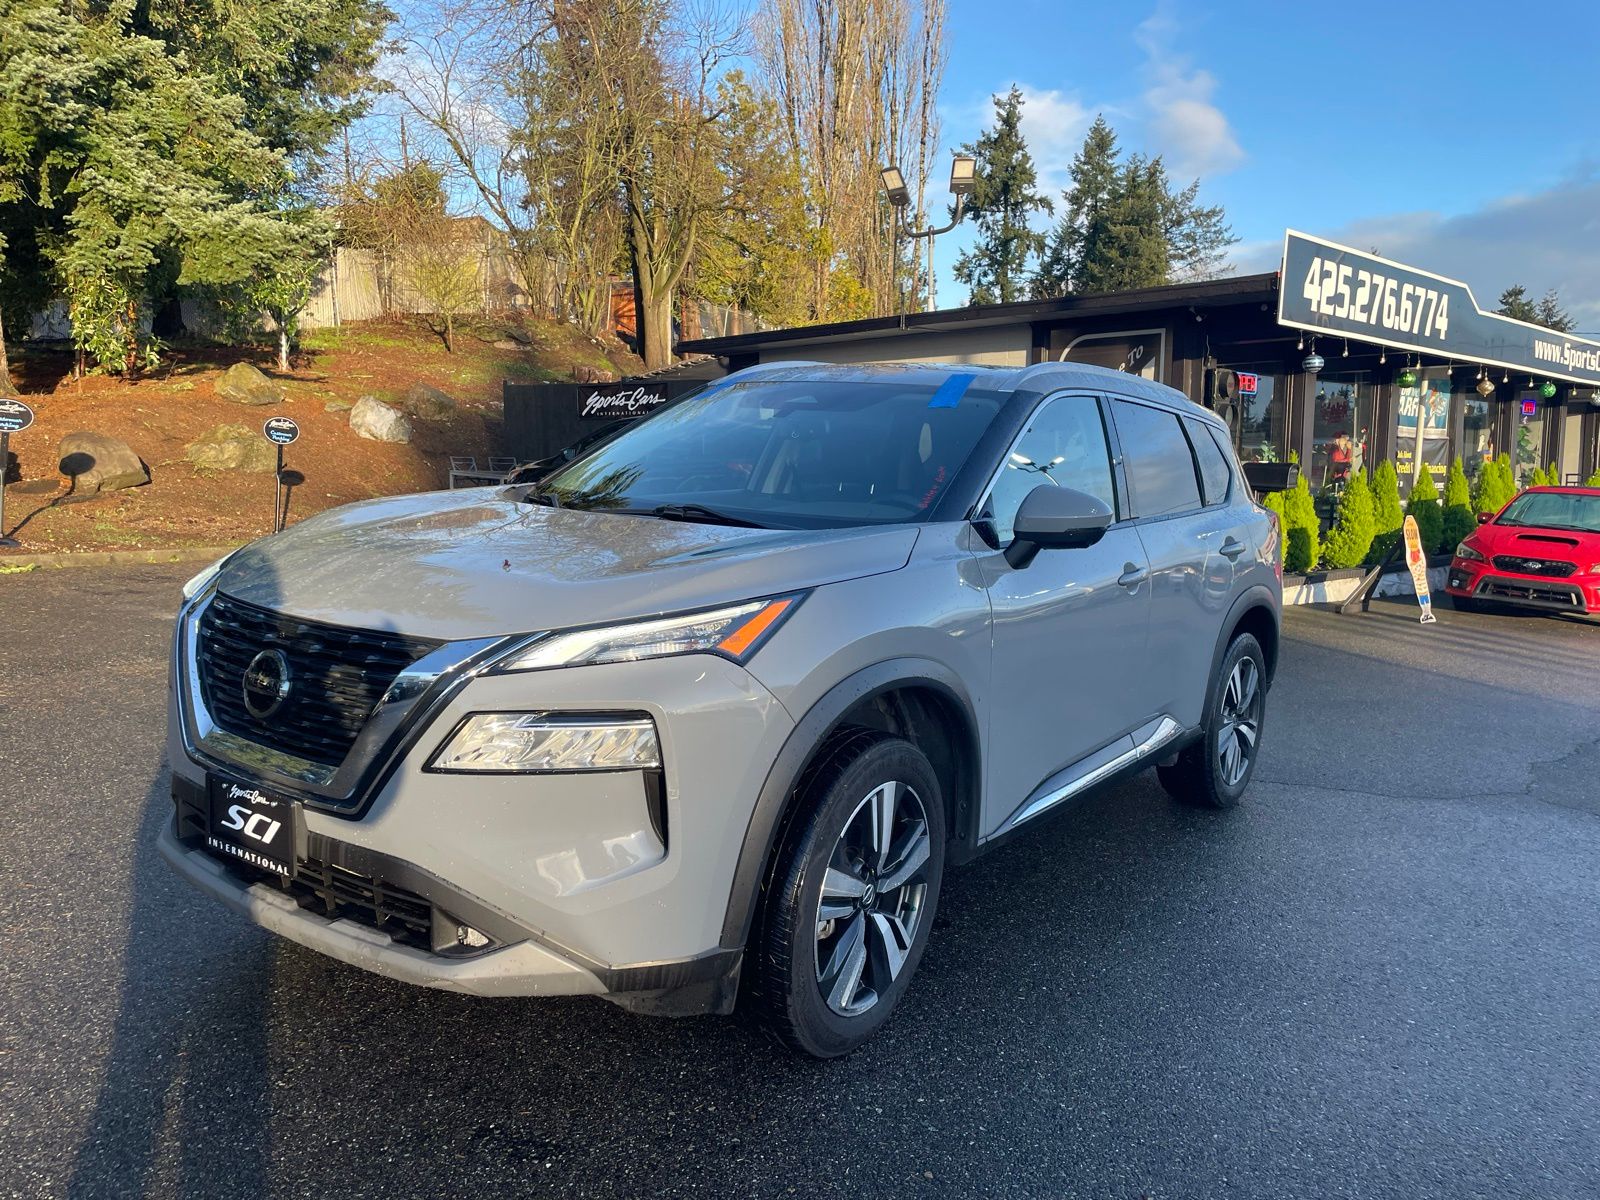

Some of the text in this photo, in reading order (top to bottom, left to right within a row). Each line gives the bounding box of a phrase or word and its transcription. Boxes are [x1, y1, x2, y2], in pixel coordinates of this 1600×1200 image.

[1303, 257, 1449, 340] 425.276.6774
[582, 387, 666, 416] Sports Cars
[229, 784, 270, 804] Sports Cars
[221, 804, 282, 844] SCI
[208, 837, 289, 876] INTERNATIONAL
